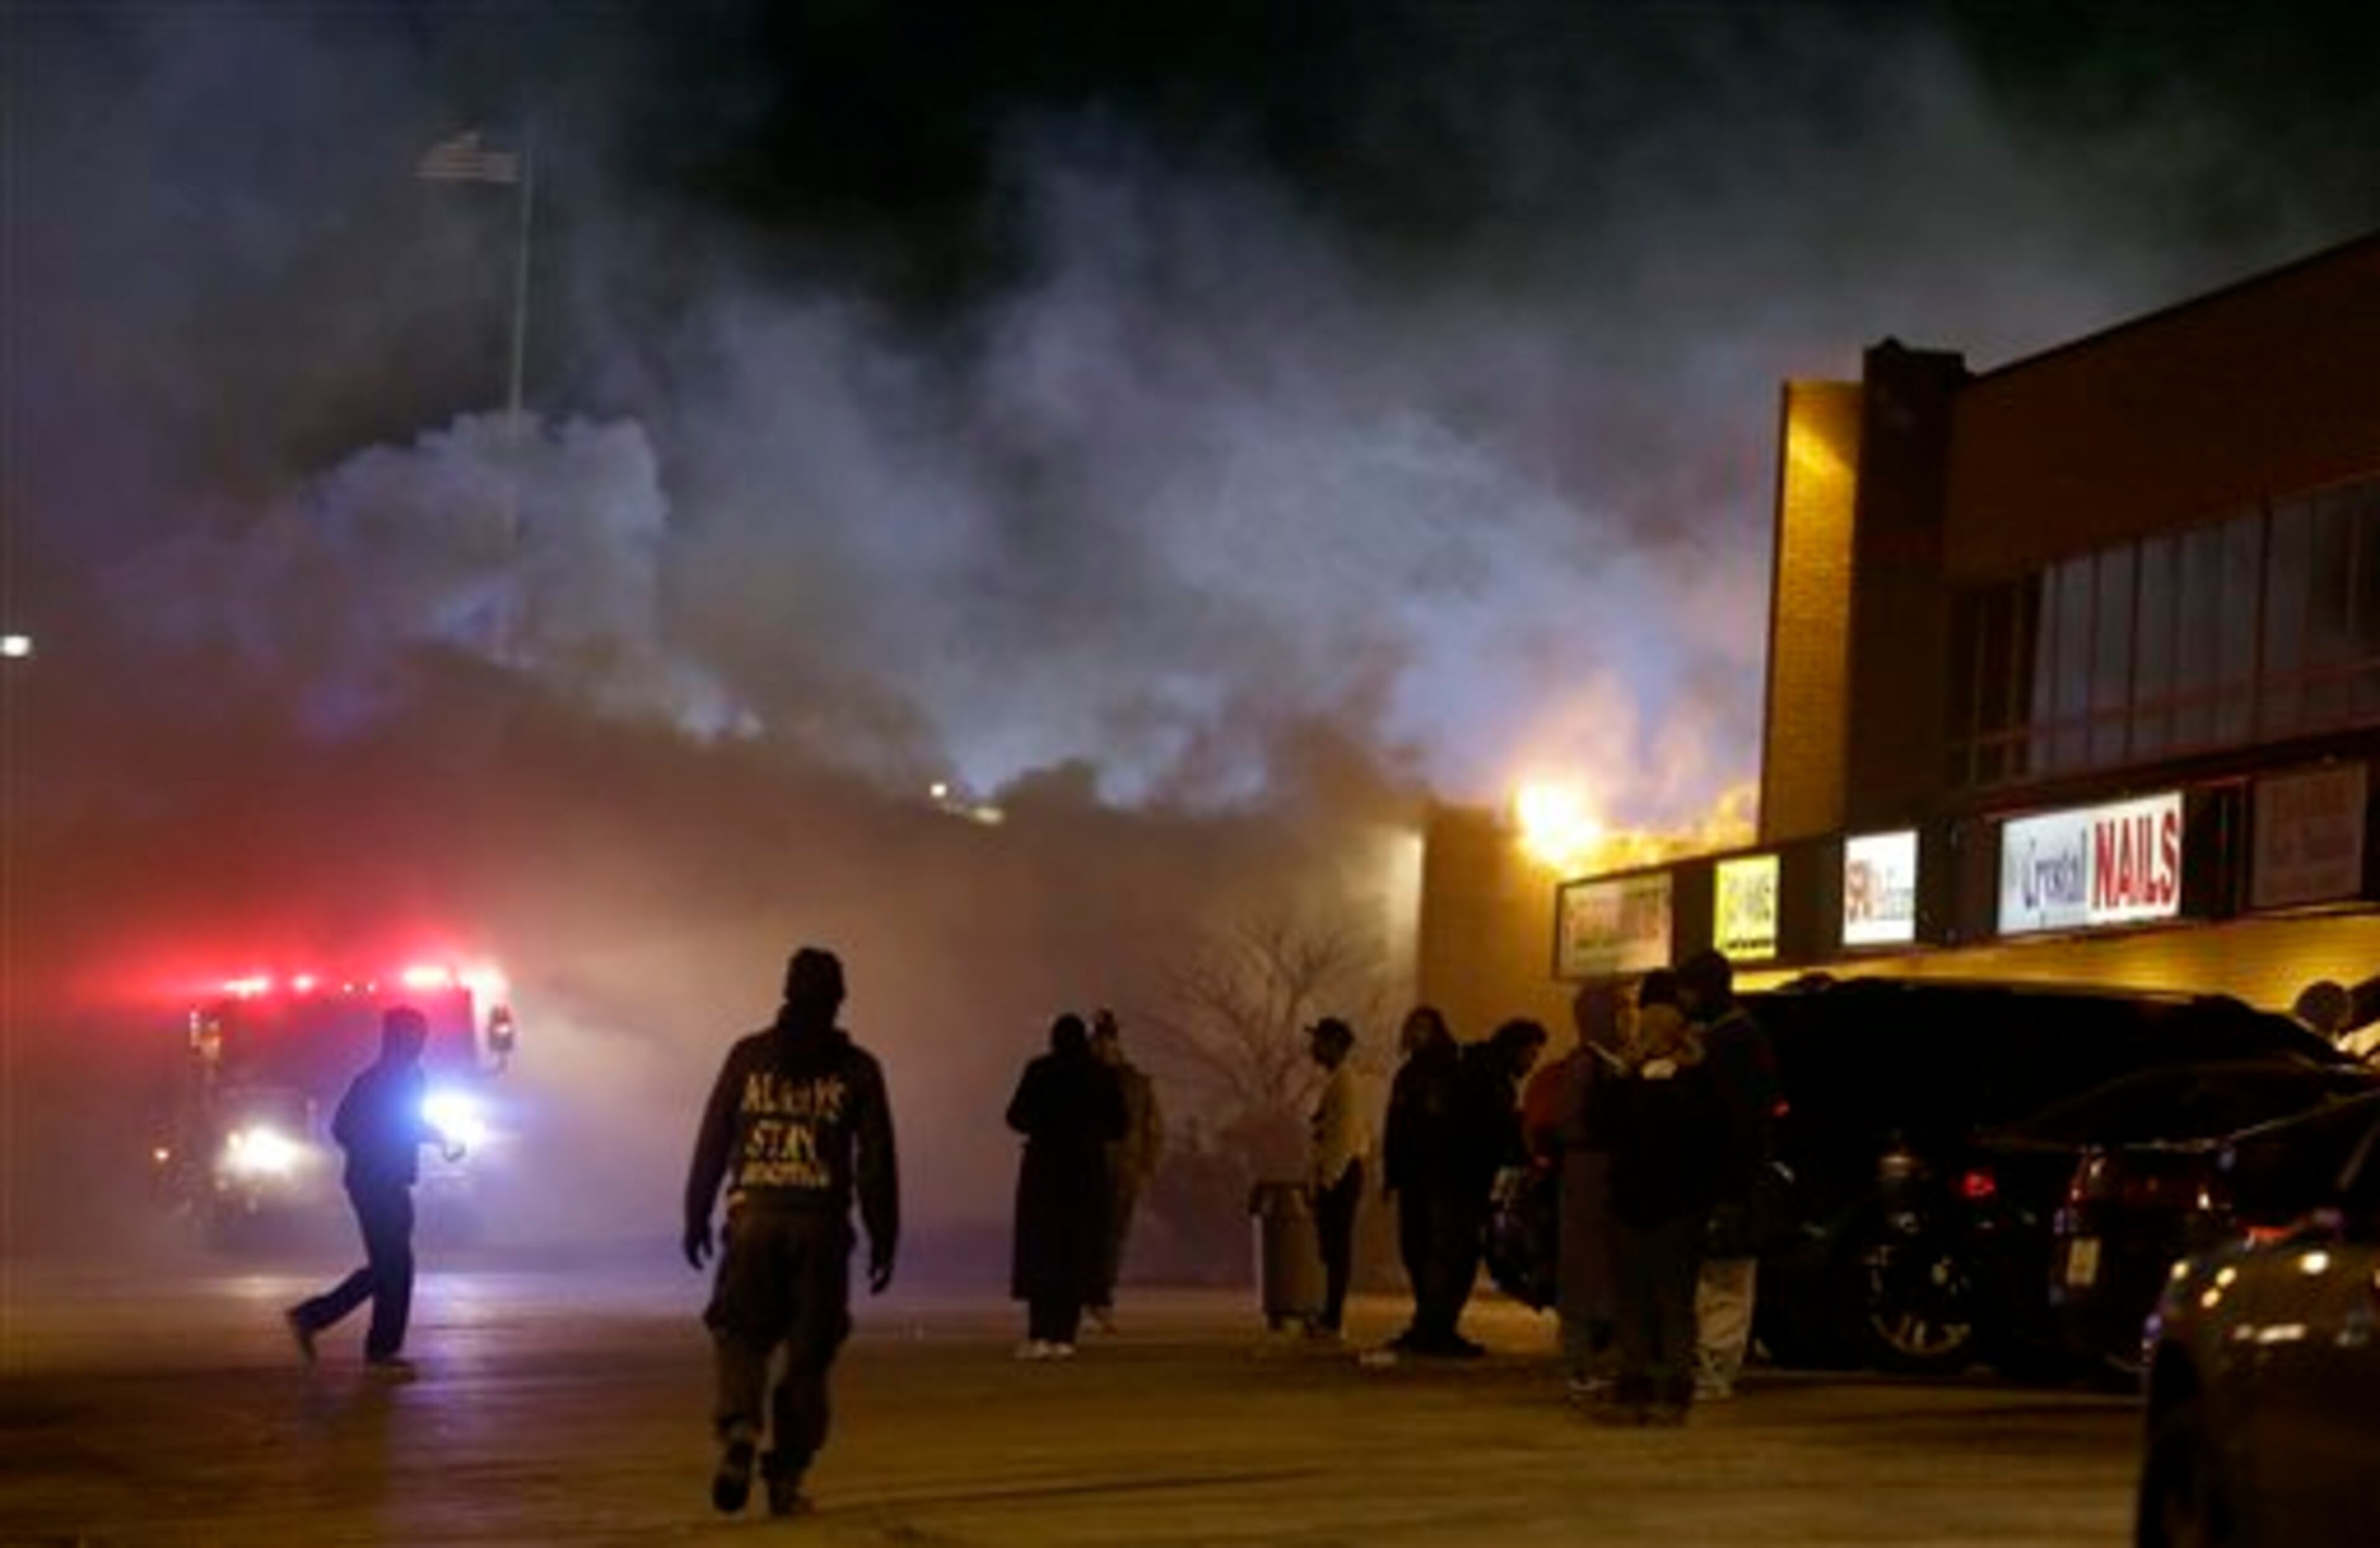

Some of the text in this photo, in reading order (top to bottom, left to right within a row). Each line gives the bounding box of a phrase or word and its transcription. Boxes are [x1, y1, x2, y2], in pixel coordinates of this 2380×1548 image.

[2021, 828, 2087, 926] Crystal
[2094, 811, 2178, 910] NAILS
[741, 1073, 845, 1122] ALWAYS
[744, 1119, 817, 1161] STAY
